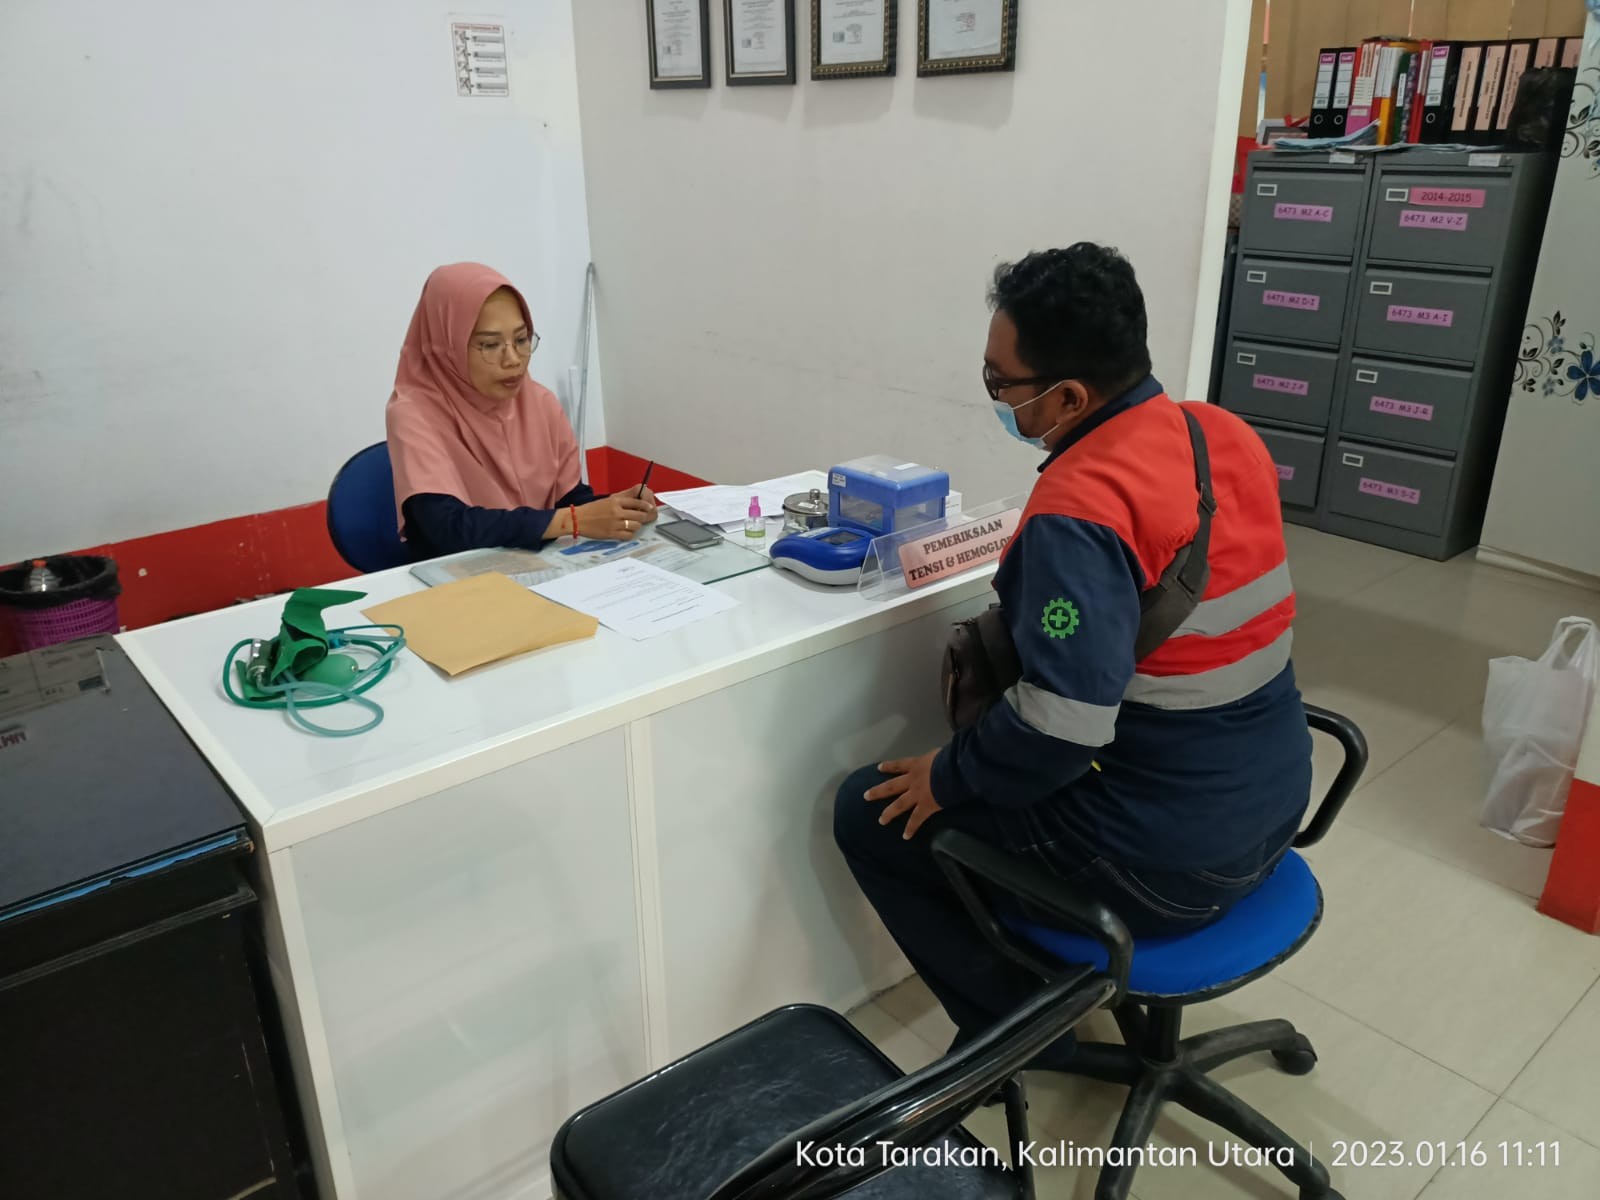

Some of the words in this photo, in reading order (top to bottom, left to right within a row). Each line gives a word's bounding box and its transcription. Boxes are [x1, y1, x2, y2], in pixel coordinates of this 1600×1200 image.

[1421, 191, 1472, 203] 2014-2015
[1278, 206, 1297, 216] 6473
[1403, 214, 1426, 223] 6473
[1429, 215, 1444, 224] M2
[1446, 216, 1464, 226] V-Z
[1391, 309, 1412, 319] 6473
[1416, 311, 1430, 320] M3
[1432, 313, 1449, 322] A-I
[1374, 400, 1394, 410] 6473
[1362, 481, 1382, 492] 6473
[923, 519, 1003, 555] PEMERIKSAAN
[908, 559, 945, 581] TENSI
[945, 556, 955, 568] &
